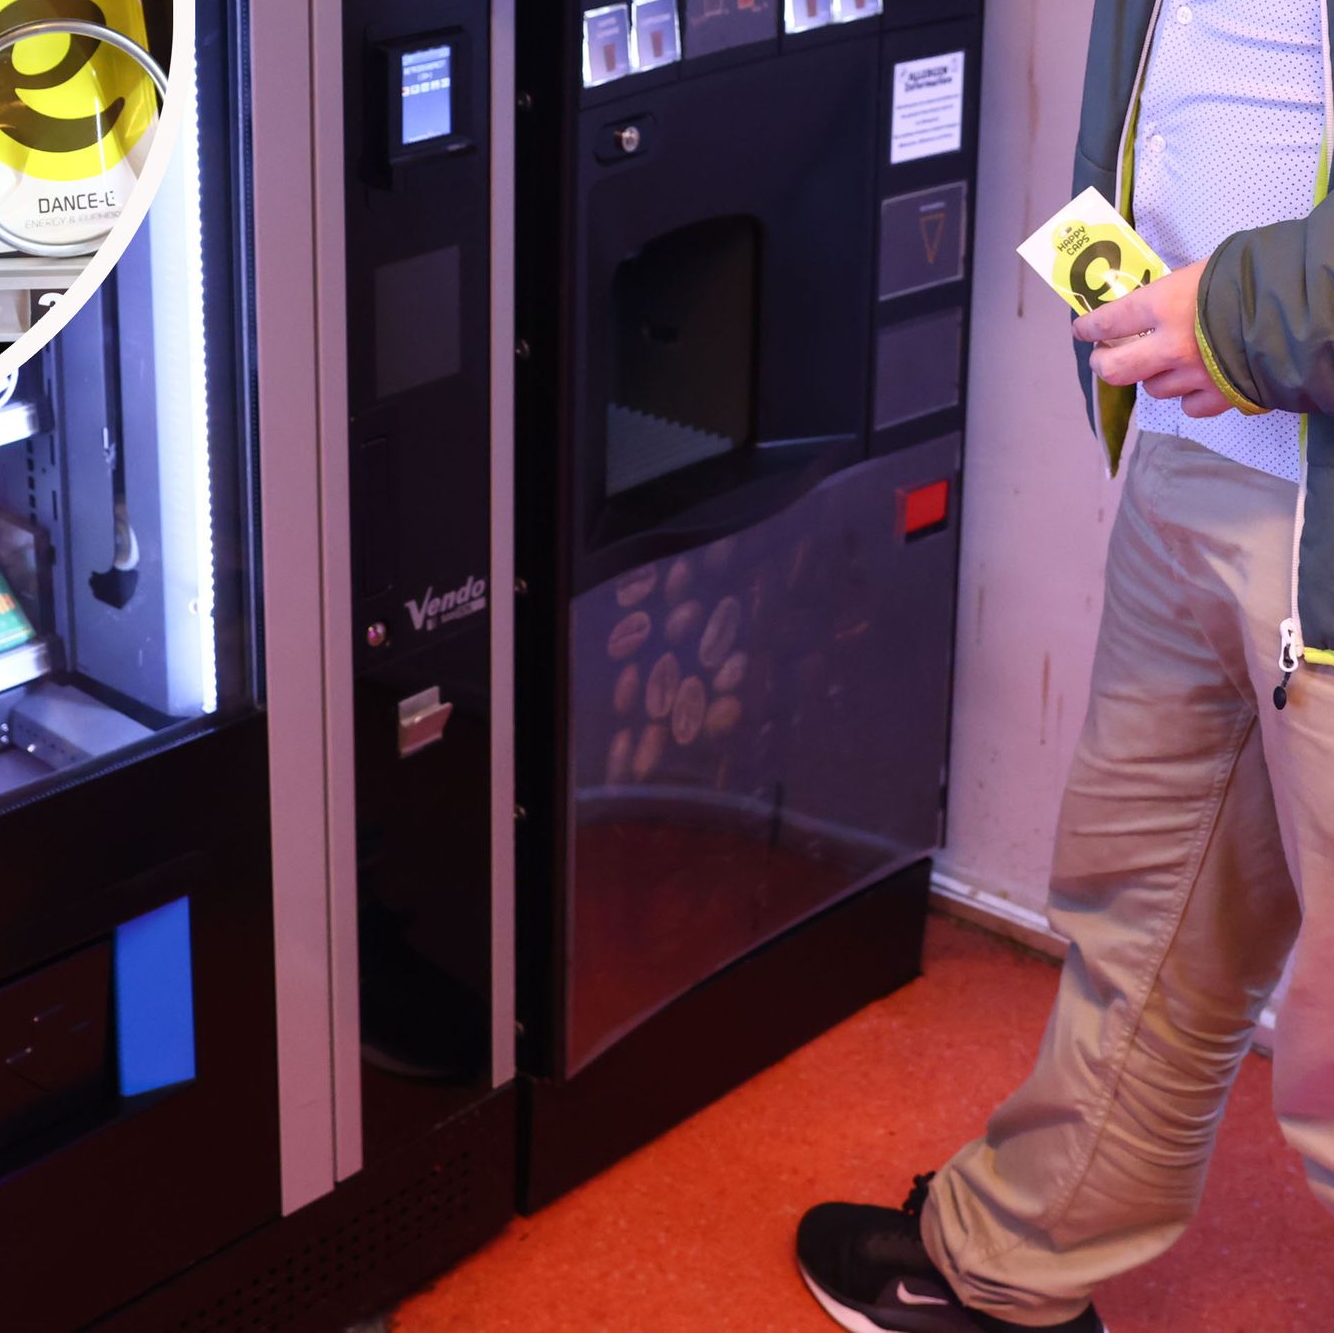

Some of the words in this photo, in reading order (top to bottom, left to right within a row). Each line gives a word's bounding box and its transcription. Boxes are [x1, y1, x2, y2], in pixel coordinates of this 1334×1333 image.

[1057, 226, 1086, 252] HAPPY
[1067, 234, 1091, 256] CAPS
[404, 576, 487, 630] Vendo
